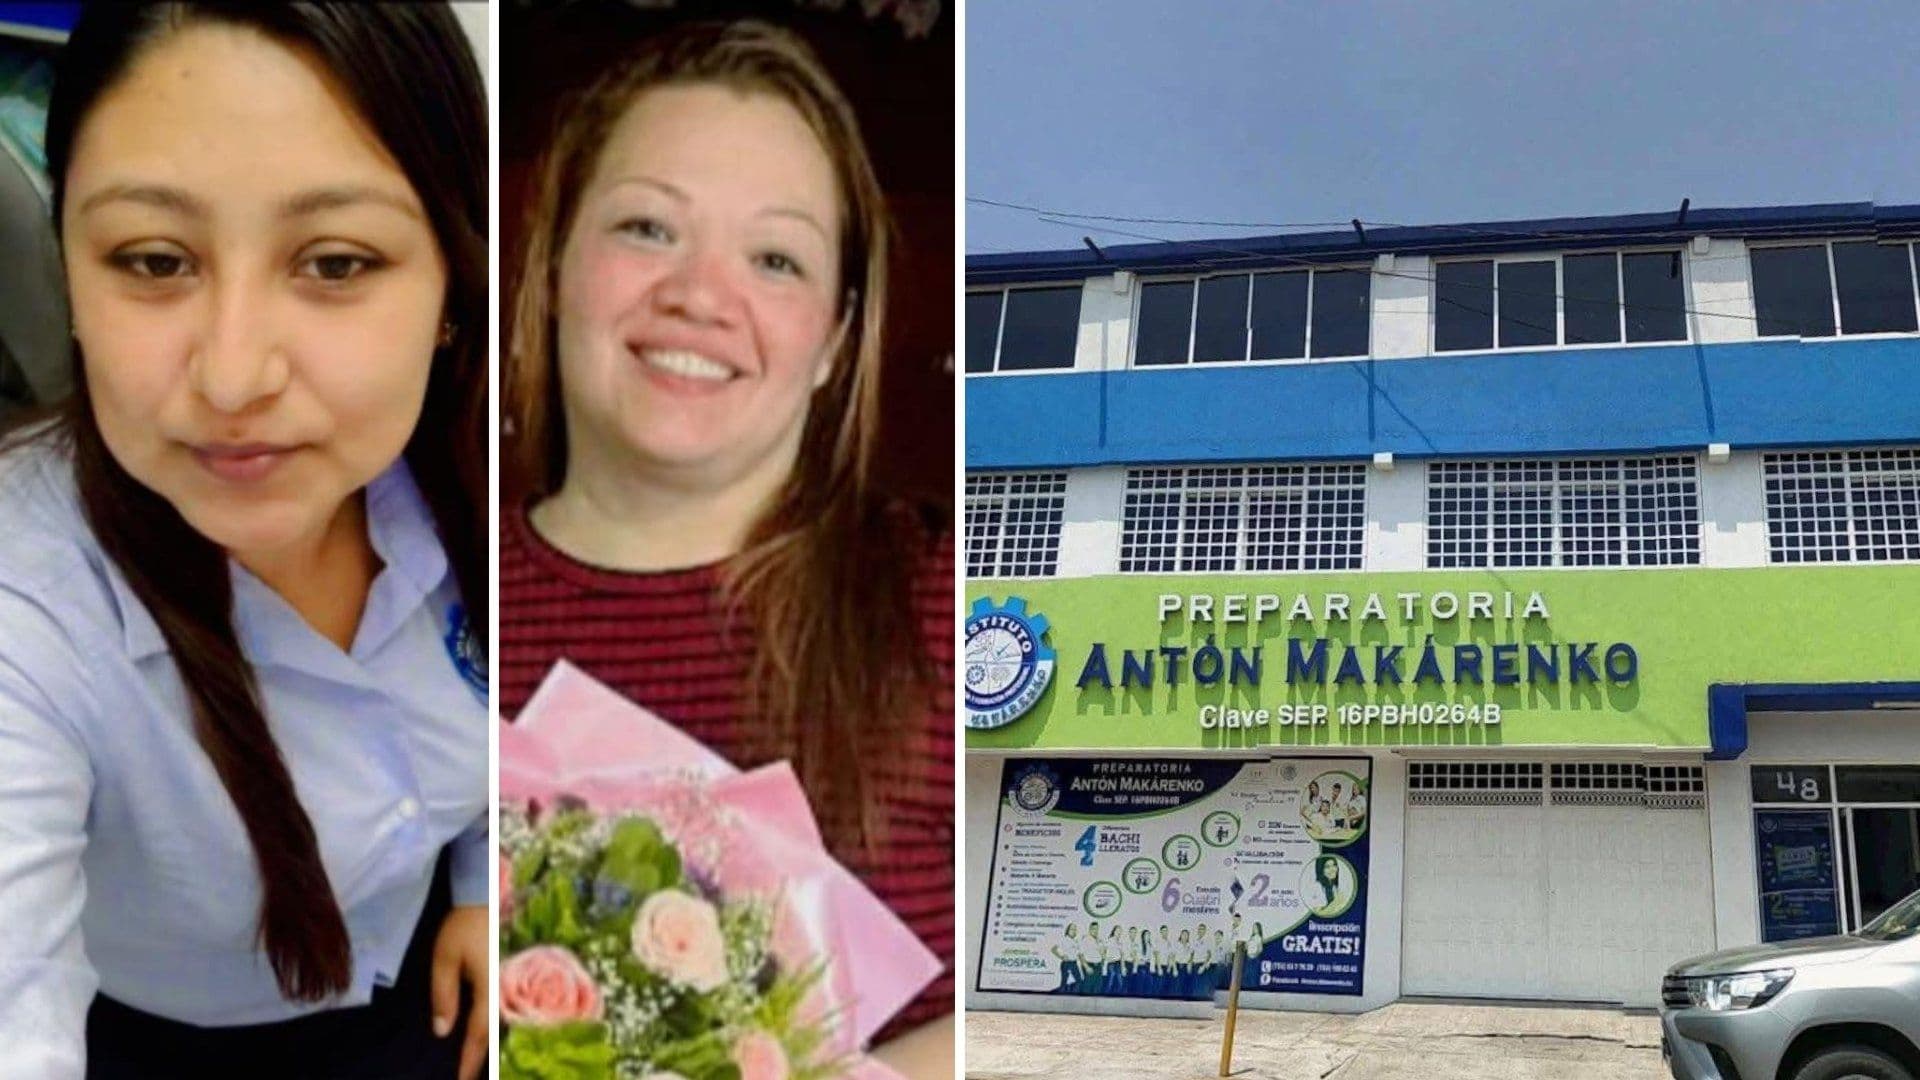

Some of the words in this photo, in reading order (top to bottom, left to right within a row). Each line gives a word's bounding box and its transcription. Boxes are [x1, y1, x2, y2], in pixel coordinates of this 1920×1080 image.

[1158, 591, 1551, 623] PREPARATORIA
[1076, 633, 1262, 689] ANTÓN
[1286, 633, 1639, 687] MAKÁRENKO
[1200, 705, 1270, 729] Clave
[1337, 703, 1501, 725] 16PBH0264B
[1093, 763, 1192, 774] PREPARATORIA
[1070, 775, 1118, 792] ANTÓN
[1120, 775, 1205, 792] MAKÁRENKO
[1075, 825, 1097, 867] 4
[1100, 833, 1140, 844] BACHI
[1161, 877, 1180, 913] 6
[1247, 872, 1271, 907] 2
[1282, 935, 1360, 956] GRATIS!
[993, 957, 1047, 969] PROSPERA
